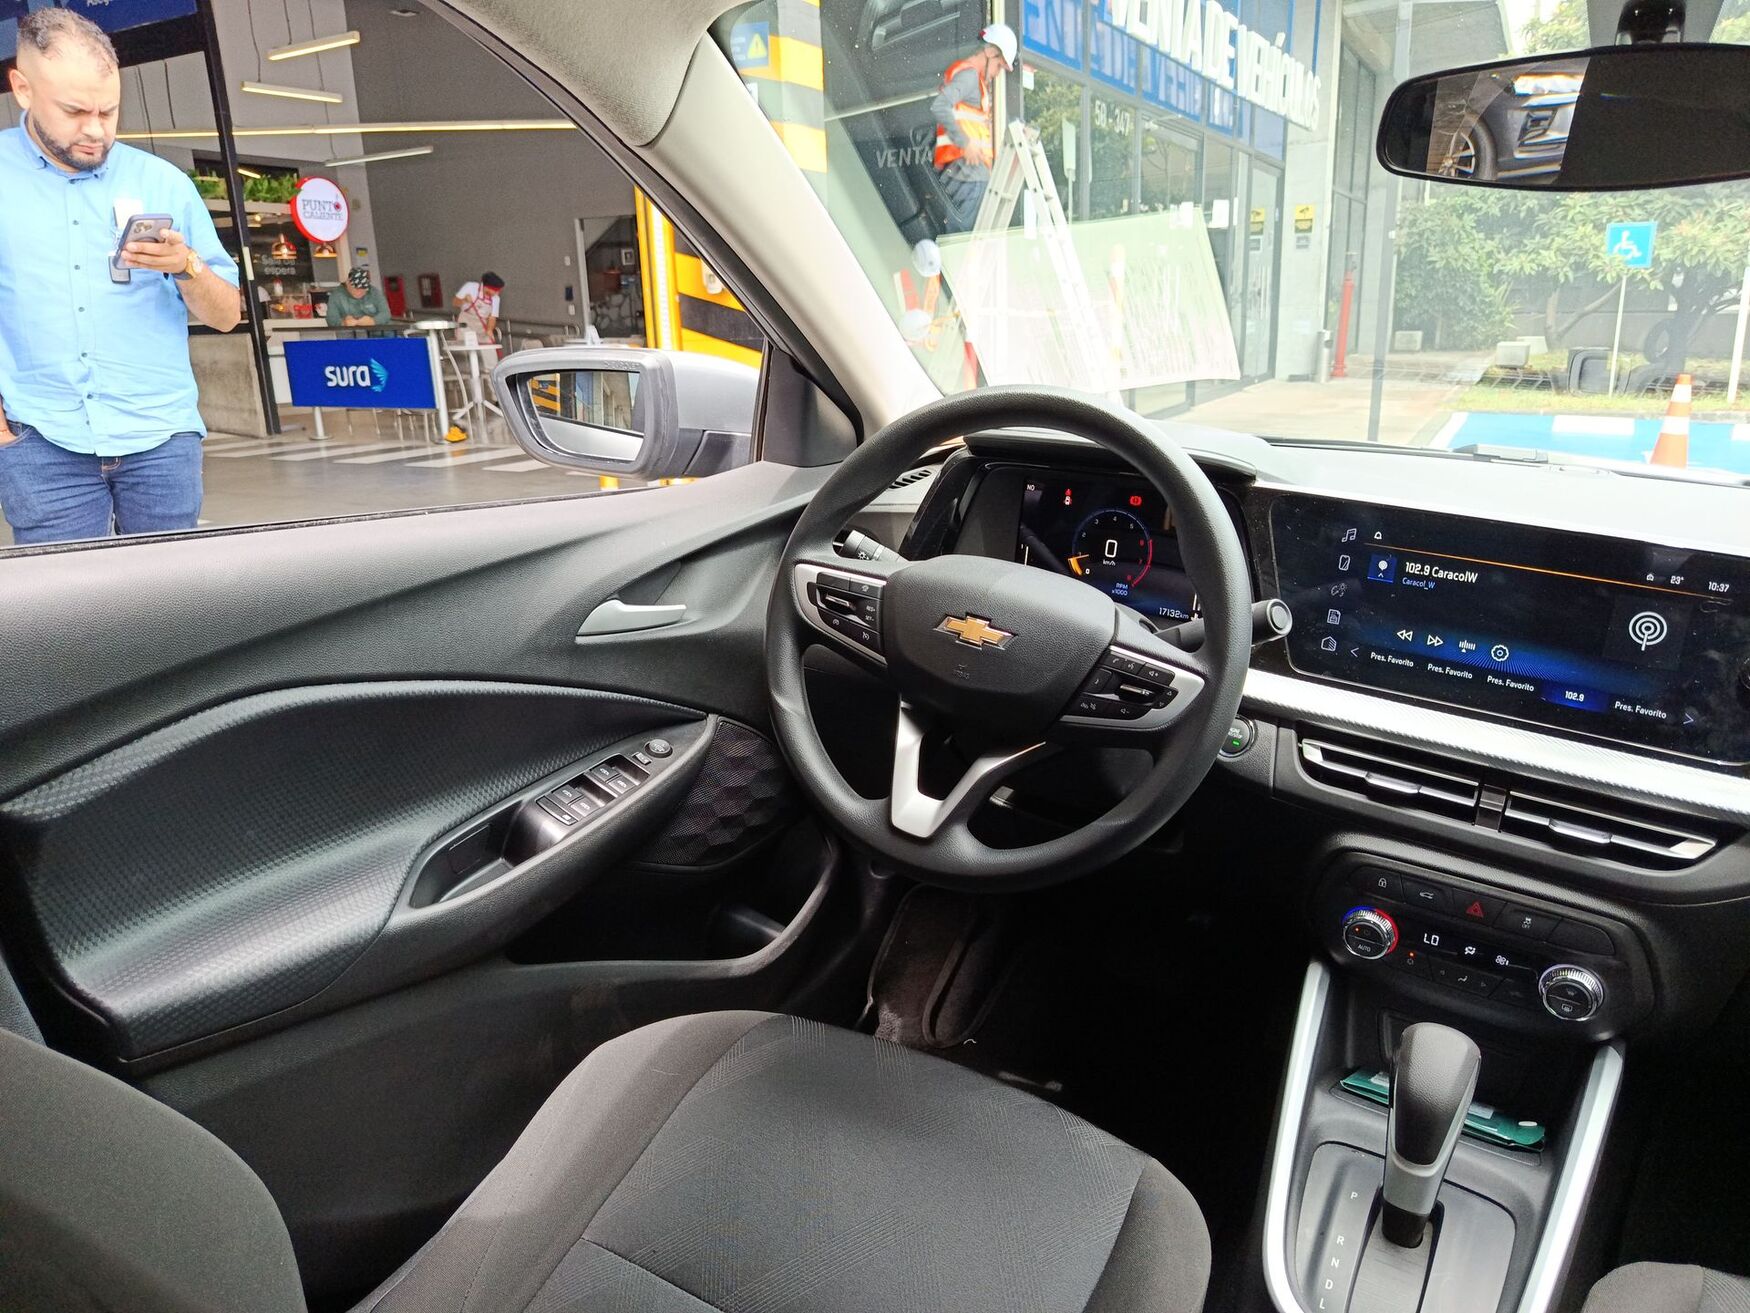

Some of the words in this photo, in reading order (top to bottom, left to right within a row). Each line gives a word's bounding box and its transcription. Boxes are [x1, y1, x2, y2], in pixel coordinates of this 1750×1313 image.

[1109, 0, 1202, 74] NTA
[1201, 0, 1239, 91] DE
[1237, 24, 1321, 131] VEHÍCULOS
[324, 365, 371, 387] sura
[1104, 539, 1118, 558] 0
[1405, 561, 1430, 576] 102.9
[1431, 566, 1478, 583] CaracolW
[1708, 581, 1730, 593] 10:37
[1370, 652, 1386, 662] Pres.
[1387, 655, 1414, 667] Favorito
[1427, 663, 1444, 674] Pres.
[1445, 667, 1473, 679] Favorito
[1487, 675, 1505, 686] Pres.
[1505, 679, 1535, 692] Favorito
[1565, 691, 1585, 702] 102.9
[1614, 701, 1634, 712] Pres.
[1635, 705, 1667, 719] Favorito
[1423, 933, 1440, 946] LO
[1357, 944, 1371, 952] AUTO
[1350, 1191, 1358, 1200] P
[1336, 1235, 1345, 1246] R
[1330, 1256, 1340, 1268] N
[1325, 1279, 1333, 1290] D
[1319, 1298, 1326, 1310] L
